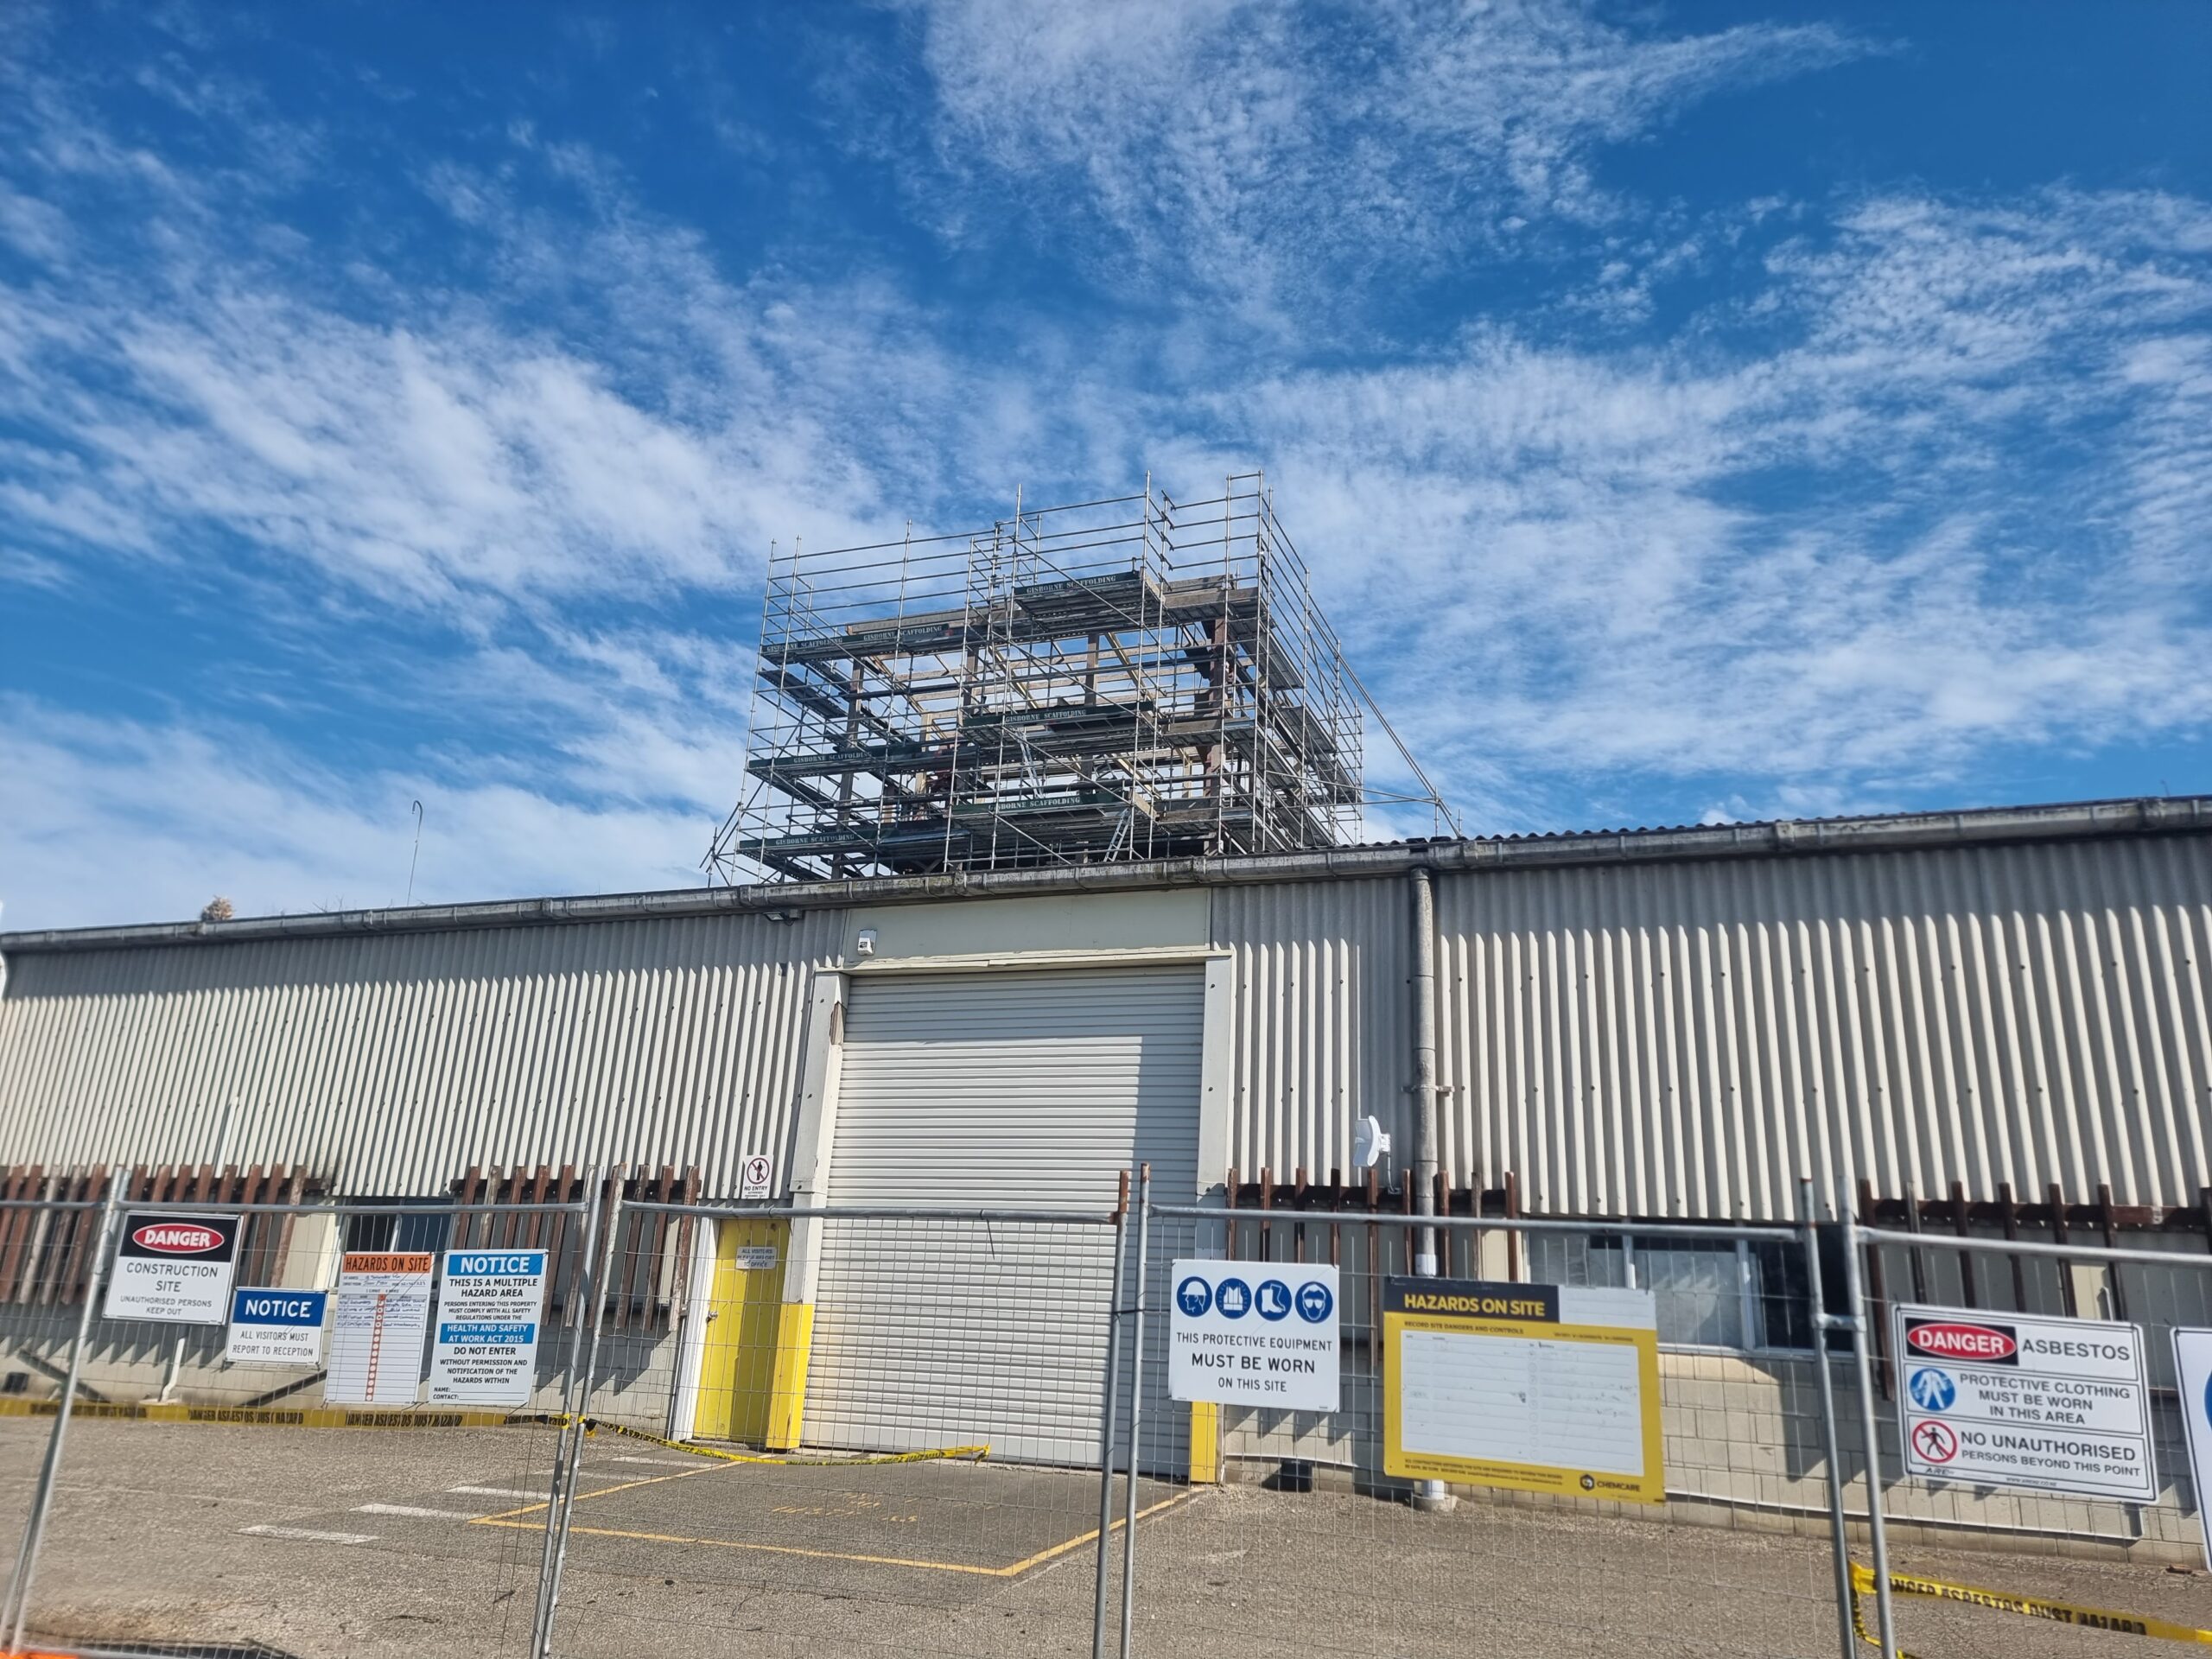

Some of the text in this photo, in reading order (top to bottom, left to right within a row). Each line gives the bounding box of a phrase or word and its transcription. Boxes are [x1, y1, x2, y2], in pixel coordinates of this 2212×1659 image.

[1027, 583, 1064, 594] GISBORNE
[863, 625, 943, 642] GISBORNE SCAFFOLDING
[1005, 709, 1087, 723] GISBORNE SCAFFOLDING
[793, 750, 873, 765] GISBORNE SCAFFOLDING
[988, 796, 1081, 811] GSBORNE SCAFFOLDING
[775, 833, 855, 847] GISBORNE SCAFFOLDING
[144, 1230, 211, 1248] DANGER
[126, 1262, 218, 1278] CONSTRUCTION
[346, 1257, 429, 1271] HAZARDS ON SITE
[460, 1256, 531, 1273] NOTICE
[156, 1281, 181, 1293] SITE
[449, 1278, 471, 1287] THIS
[493, 1278, 537, 1287] MULTIPLE
[120, 1296, 213, 1307] UNAUTHORISED PERSONS
[245, 1300, 312, 1318] NOTICE
[1404, 1293, 1546, 1317] HAZARDS ON SITE
[240, 1331, 308, 1342] ALL VISITORS MUST
[1444, 1323, 1474, 1332] DANGERS
[1490, 1326, 1524, 1335] CONTROLS
[1176, 1332, 1332, 1351] THIS PROTECTIVE EQUIPMENT
[1918, 1330, 2005, 1354] DANGER
[232, 1344, 313, 1357] REPORT TO RECEPTION
[454, 1347, 517, 1356] DO NOT ENTER
[2022, 1339, 2131, 1361] ASBESTOS
[1192, 1353, 1315, 1374] MUST BE WORN
[1217, 1377, 1287, 1392] ON THIS SITE
[1960, 1373, 2131, 1399] PROTECTIVE CLOTHING
[1979, 1390, 2094, 1411] MUST BE WORN
[1990, 1405, 2085, 1425] IN THIS AREA
[1961, 1431, 2136, 1461] NO UNAUTHORISED
[1961, 1450, 2141, 1477] PERSONS BEYOND THIS POINT
[1596, 1481, 1641, 1492] CHEMCARE
